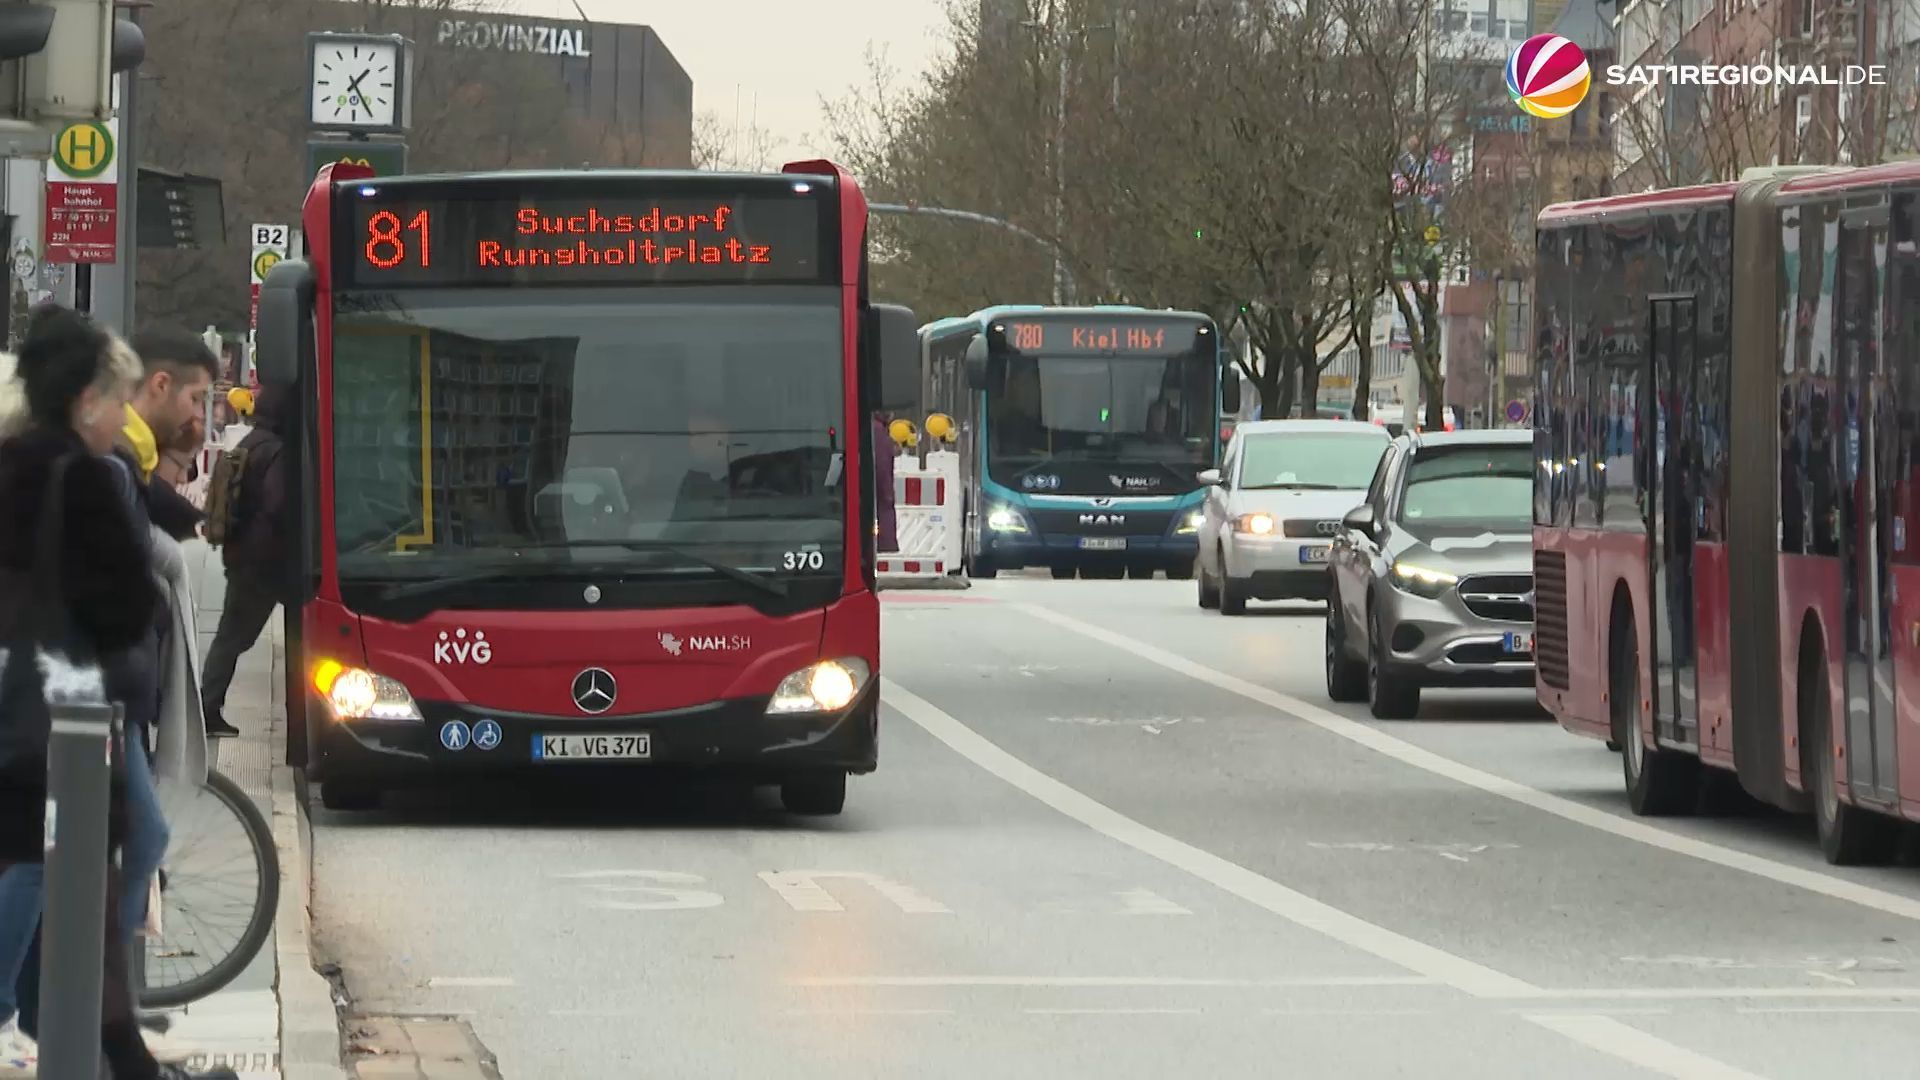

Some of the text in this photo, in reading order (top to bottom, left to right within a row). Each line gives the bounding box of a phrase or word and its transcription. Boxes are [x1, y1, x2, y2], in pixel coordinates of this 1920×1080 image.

[437, 19, 591, 57] PROVINZIAL
[63, 185, 96, 196] Haupt-
[63, 197, 103, 206] bahnhof
[517, 206, 731, 234] Suchsdorf
[257, 228, 282, 245] B2
[365, 209, 430, 267] 81
[478, 237, 772, 266] Rungholtplatz
[1013, 324, 1164, 349] 780 Kiel Hbf
[1079, 514, 1125, 525] MAN
[783, 551, 823, 570] 370
[434, 640, 491, 664] KVG
[689, 635, 751, 650] NAH.SH
[544, 737, 648, 756] KI VG 370
